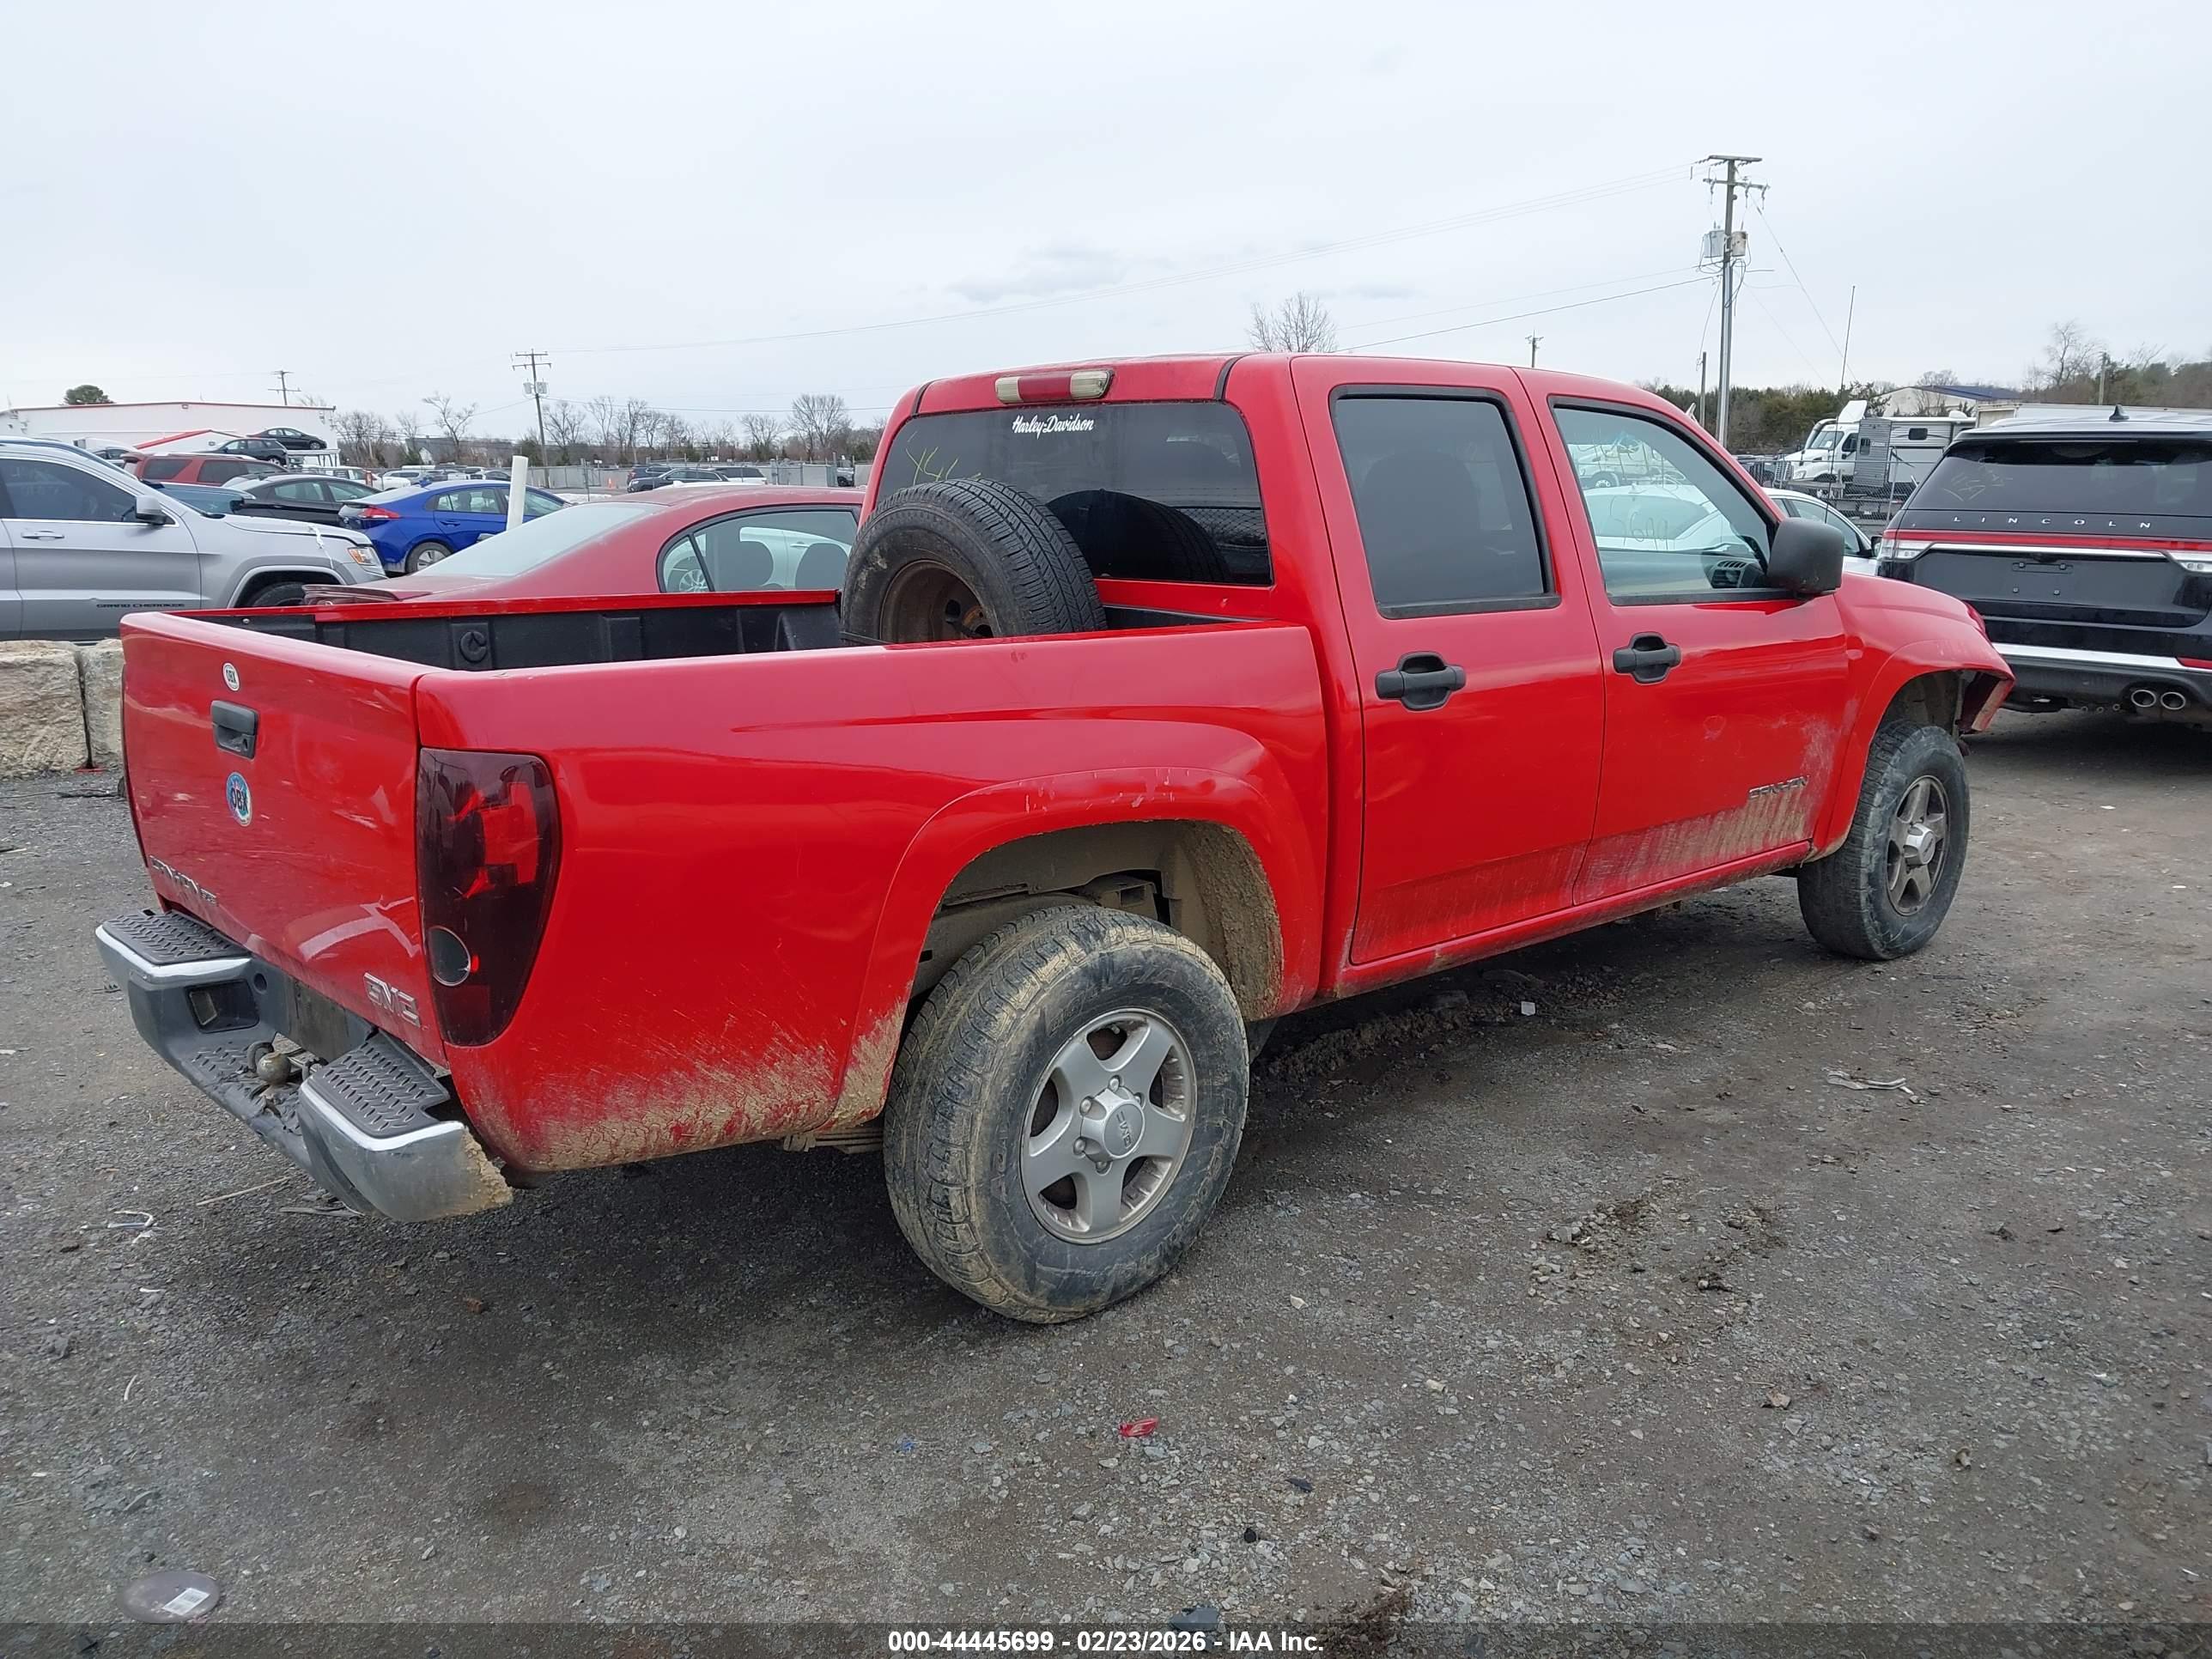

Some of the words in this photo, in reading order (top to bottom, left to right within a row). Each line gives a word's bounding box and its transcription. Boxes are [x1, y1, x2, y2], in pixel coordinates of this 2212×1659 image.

[1012, 413, 1095, 440] Harley-Davidson
[1954, 517, 2151, 529] LINCOLN
[231, 787, 249, 815] OBX
[363, 972, 421, 1028] GMC
[1116, 1111, 1133, 1148] GMC
